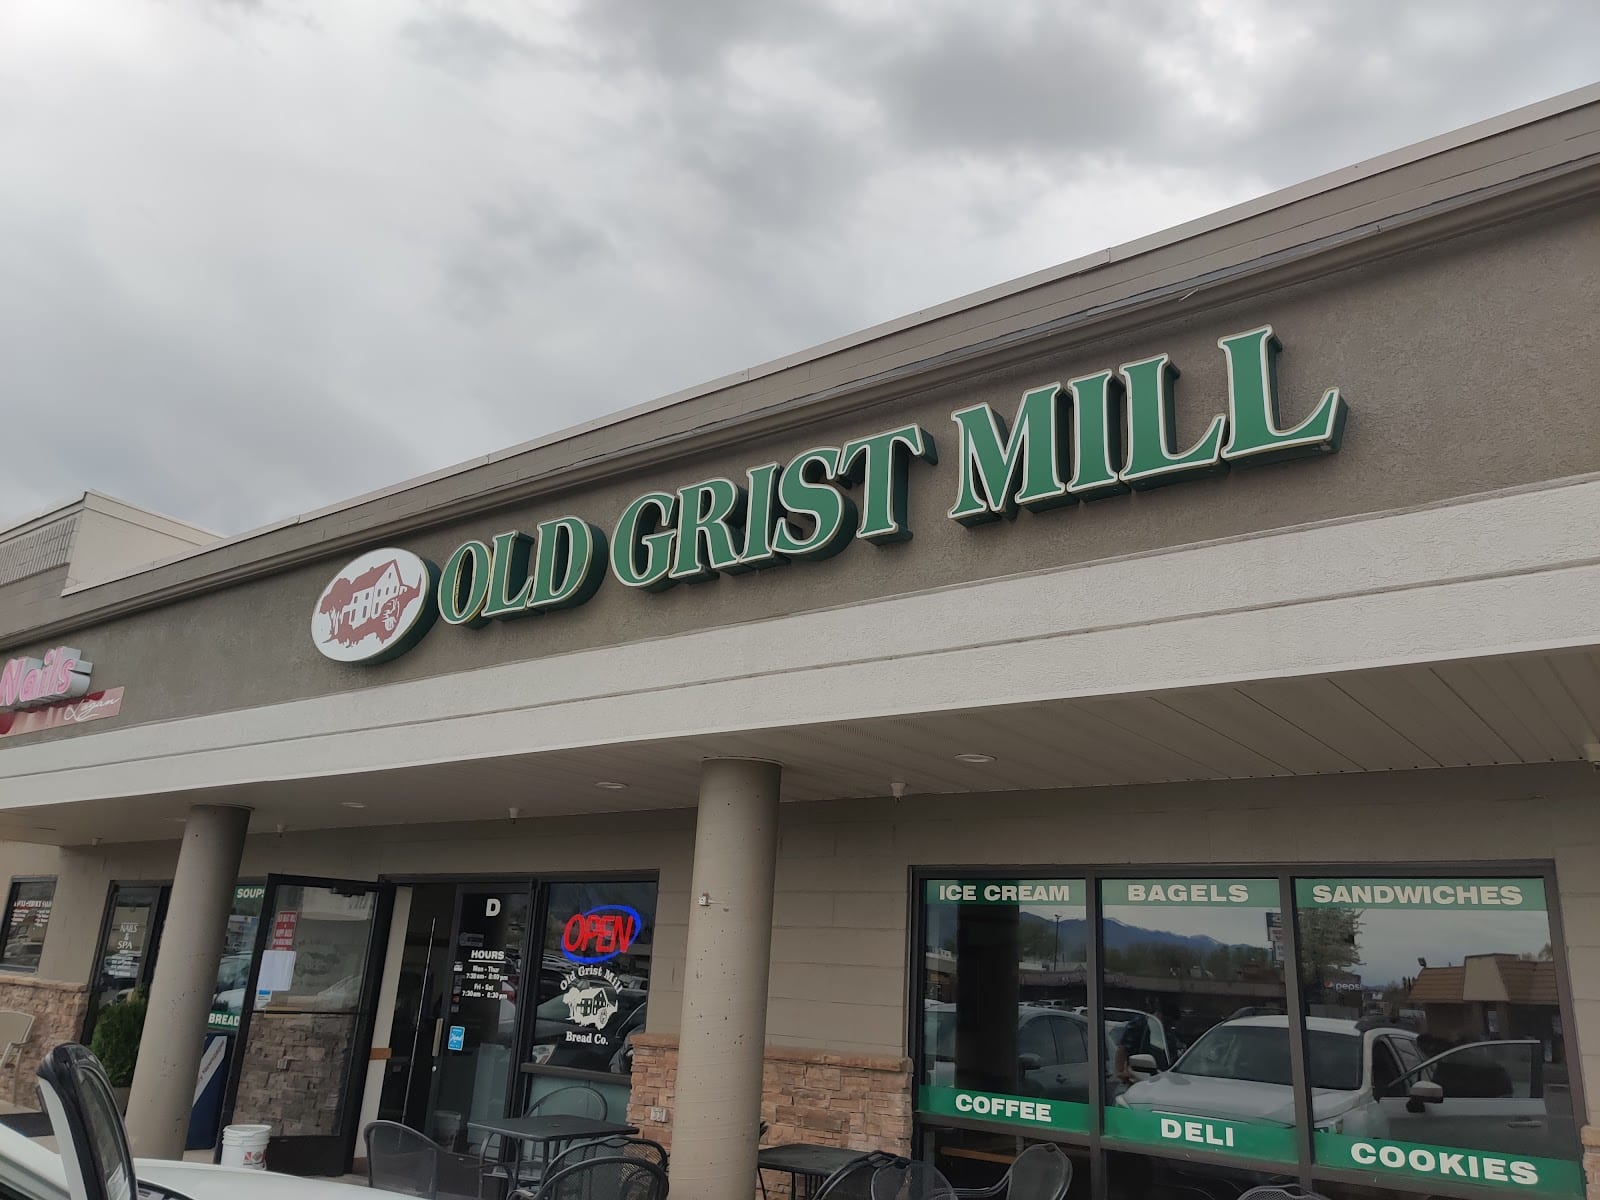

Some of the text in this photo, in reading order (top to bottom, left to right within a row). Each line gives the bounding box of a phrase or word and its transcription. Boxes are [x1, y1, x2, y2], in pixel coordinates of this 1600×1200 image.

[436, 323, 1341, 627] OLD GRIST MILL
[0, 646, 77, 706] Nails
[939, 885, 1070, 902] ICE CREAM
[1127, 884, 1249, 903] BAGELS
[1312, 884, 1523, 906] SANDWICHES
[485, 898, 501, 917] D
[117, 940, 133, 950] SPA
[562, 913, 634, 953] OPEN
[470, 949, 505, 960] HOURS
[559, 965, 624, 995] Old Grist Mill
[565, 1031, 609, 1046] Bread Co.
[955, 1093, 1052, 1123] COFFEE
[1160, 1118, 1235, 1148] DELI
[1350, 1142, 1539, 1186] COOKIES
